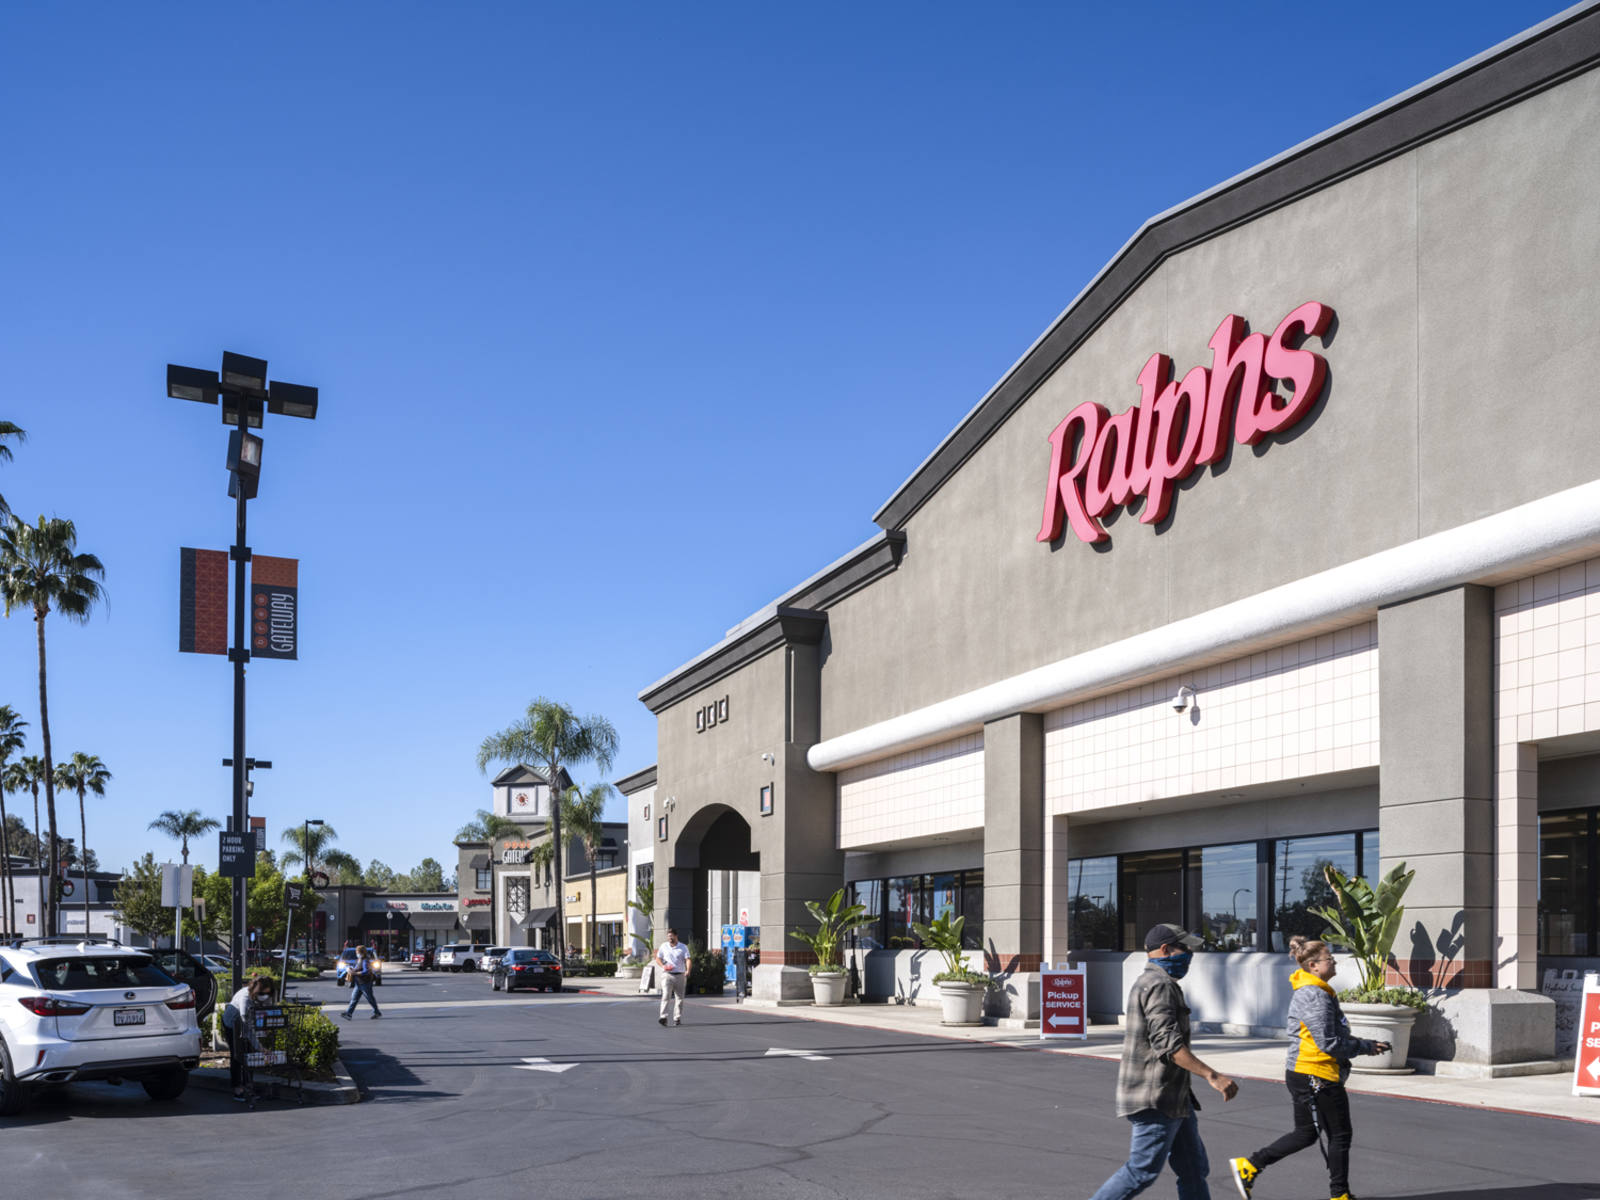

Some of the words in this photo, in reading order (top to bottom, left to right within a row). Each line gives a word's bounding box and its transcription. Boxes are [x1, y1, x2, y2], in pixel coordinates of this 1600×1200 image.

[1036, 301, 1334, 543] Ralphs
[270, 592, 295, 653] GATEWAY
[1047, 992, 1079, 1000] Pickup
